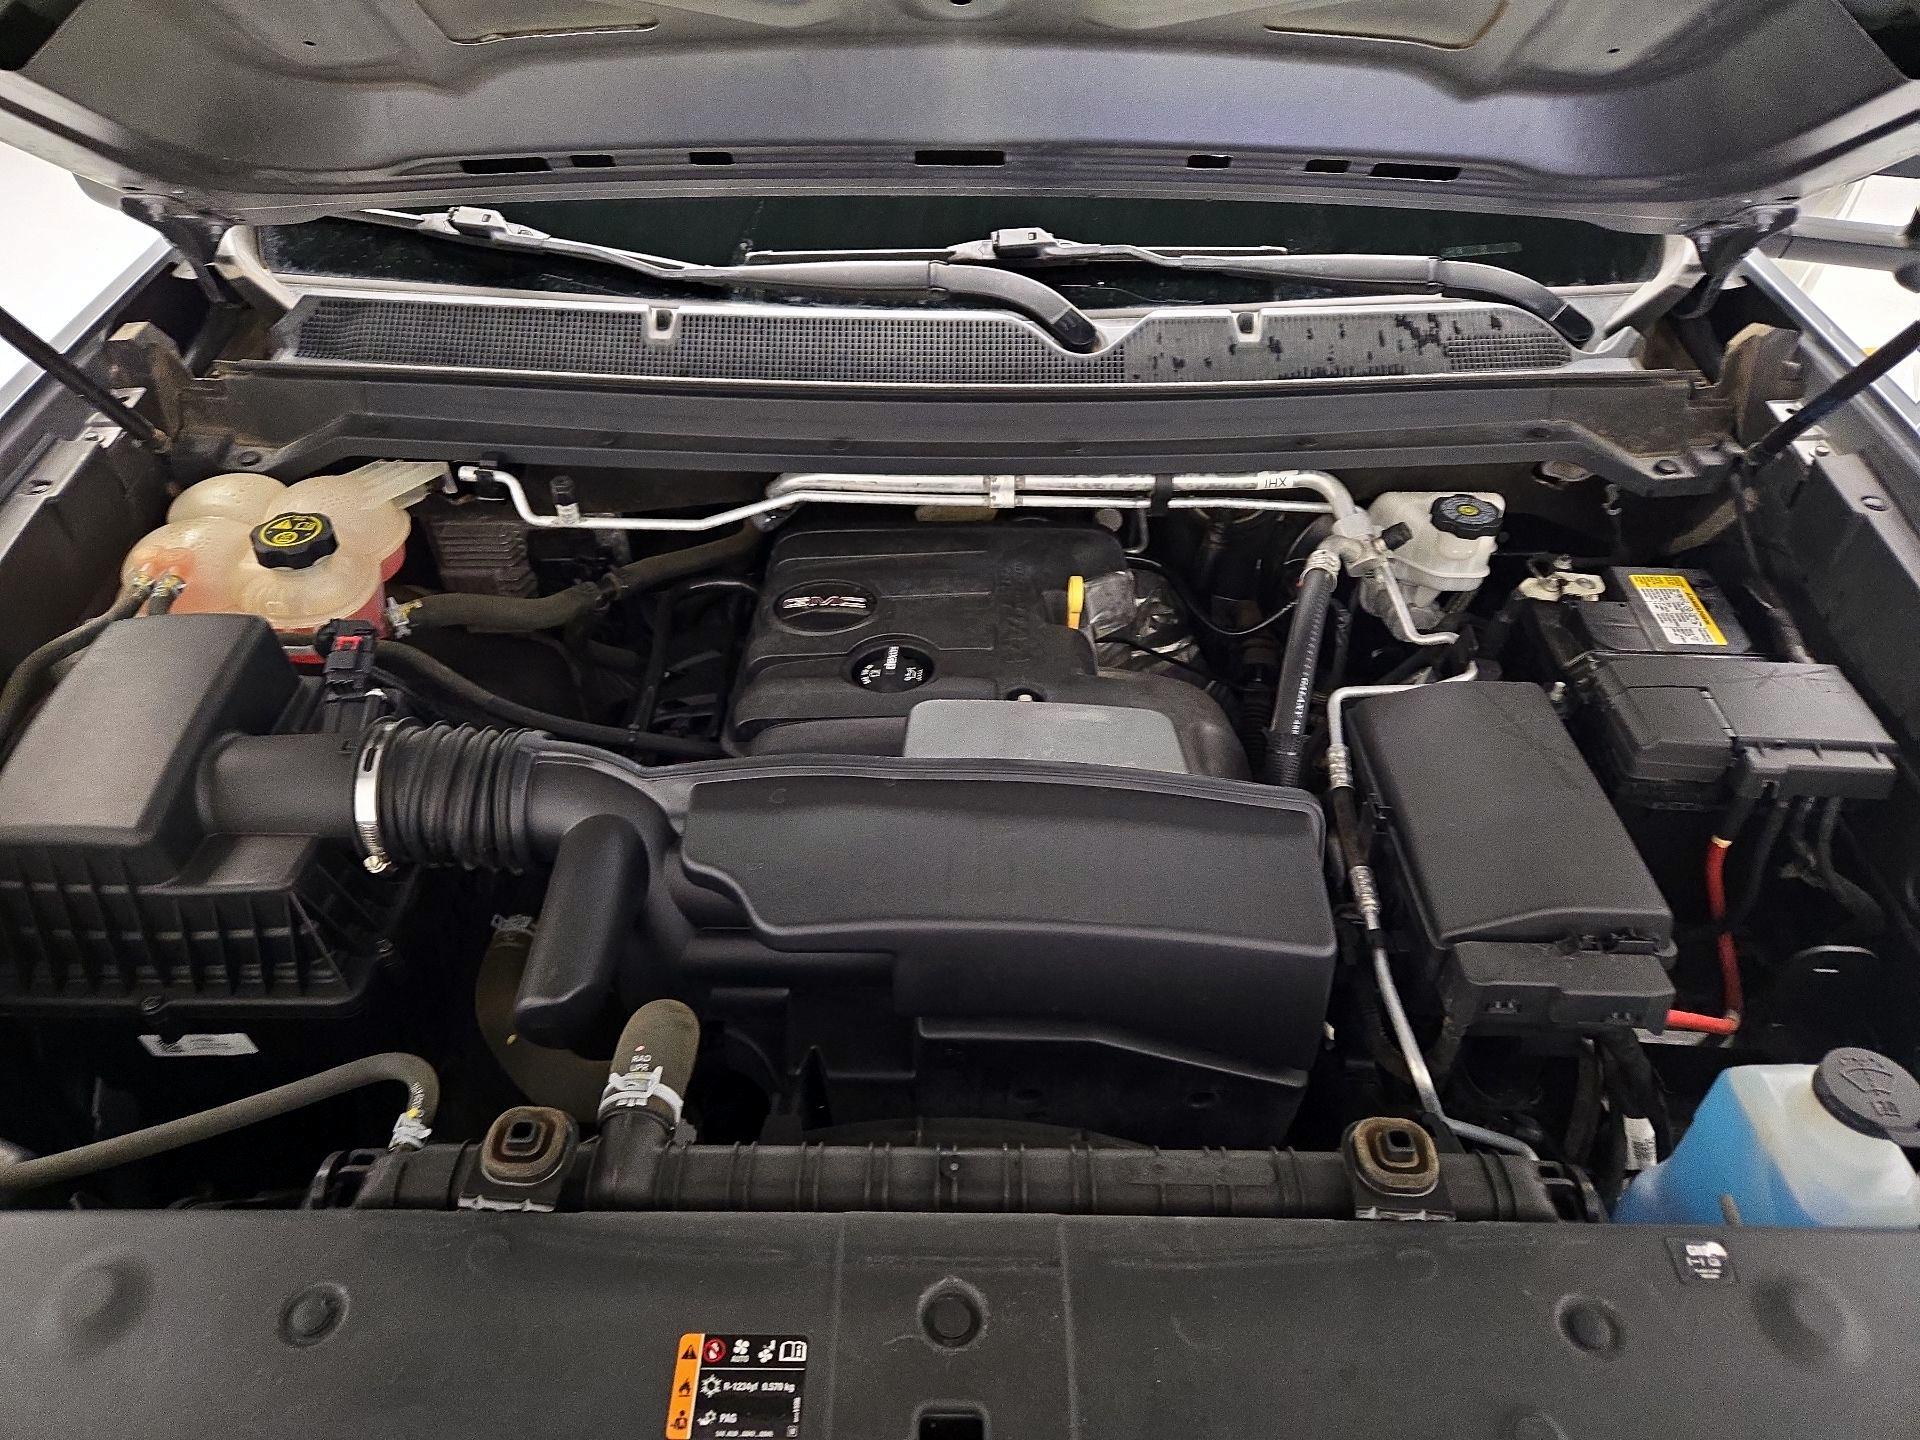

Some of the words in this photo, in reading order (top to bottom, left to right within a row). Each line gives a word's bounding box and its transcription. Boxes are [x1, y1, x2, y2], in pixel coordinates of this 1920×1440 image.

[782, 595, 867, 609] GMC
[784, 1382, 795, 1392] kg
[719, 1412, 738, 1423] PAG
